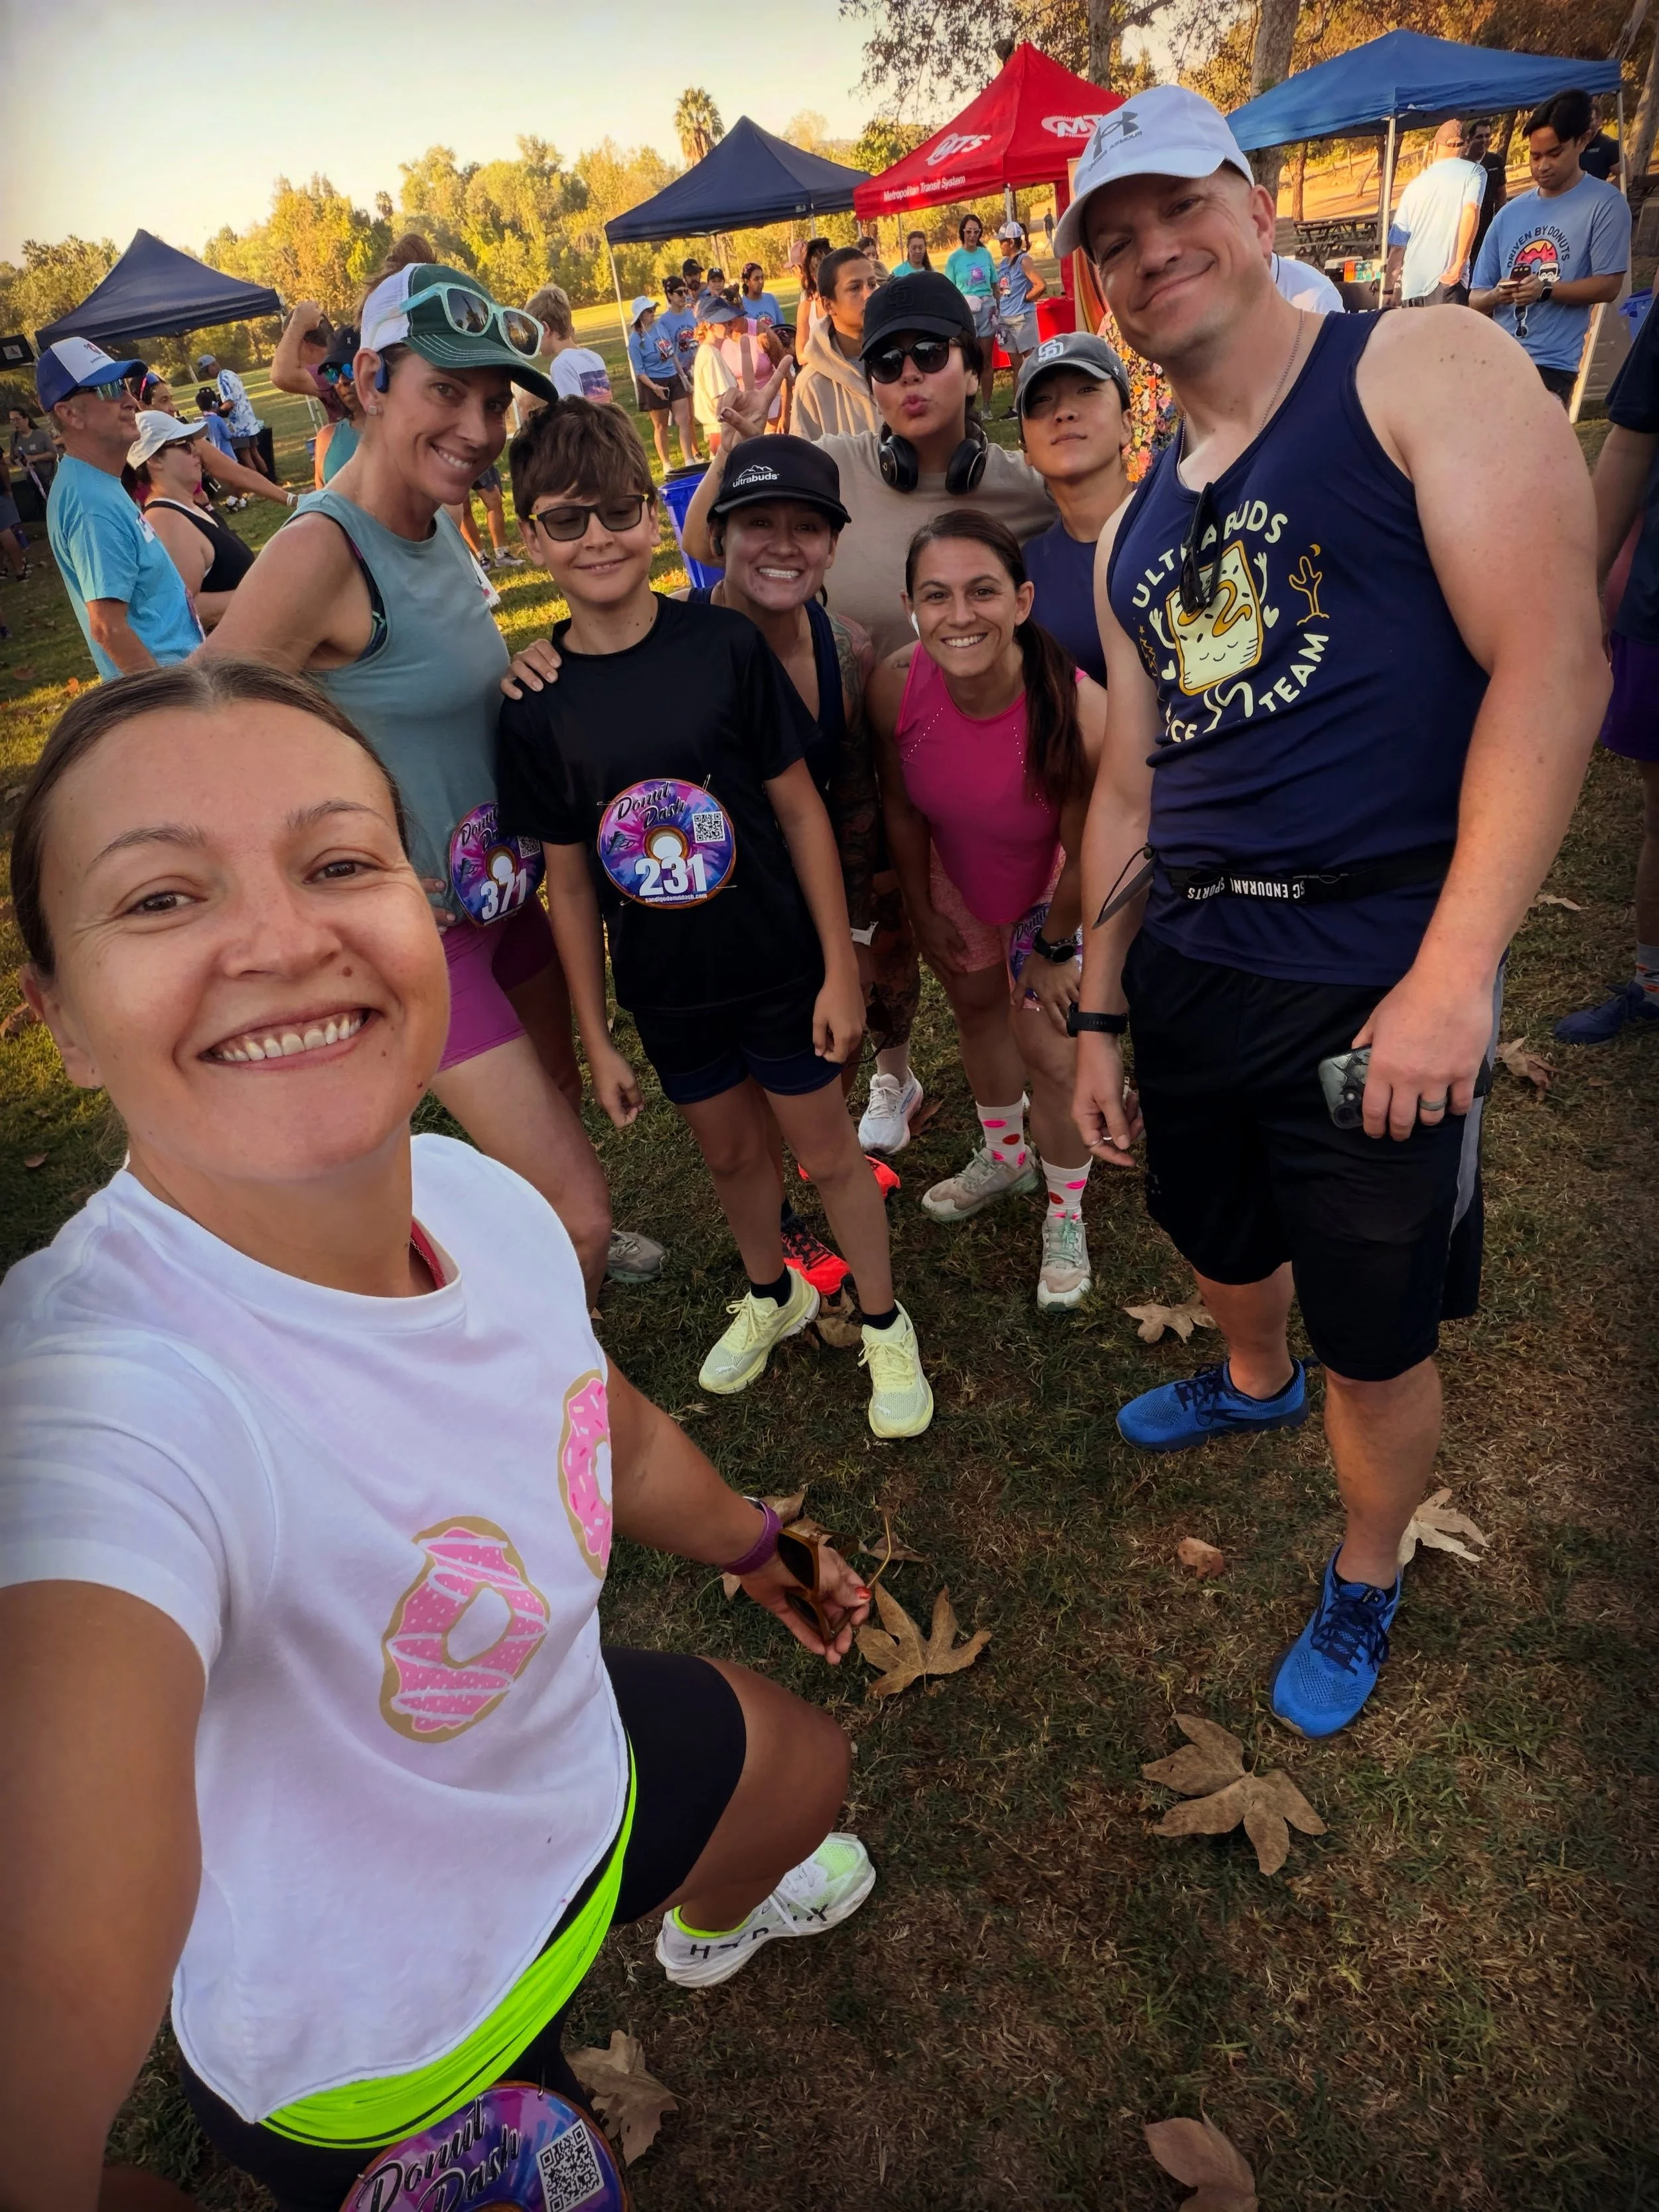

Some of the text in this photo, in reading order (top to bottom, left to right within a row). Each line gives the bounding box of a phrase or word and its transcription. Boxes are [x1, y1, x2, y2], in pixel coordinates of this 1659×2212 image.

[1056, 115, 1102, 137] MT
[1110, 131, 1143, 150] ARMOUR
[883, 175, 966, 202] Metropolitan Transit System
[1507, 226, 1571, 269] DRIVEN BY DONUTS
[1038, 339, 1064, 362] SD
[733, 473, 778, 488] ultrabuds
[1258, 633, 1329, 712] TEAM
[613, 780, 670, 822] Donut
[637, 796, 685, 832] Dash
[634, 853, 707, 896] 231
[1187, 876, 1225, 901] SPORTS
[480, 868, 527, 921] 371
[356, 2095, 486, 2212] Donut
[418, 2123, 522, 2212] Dash
